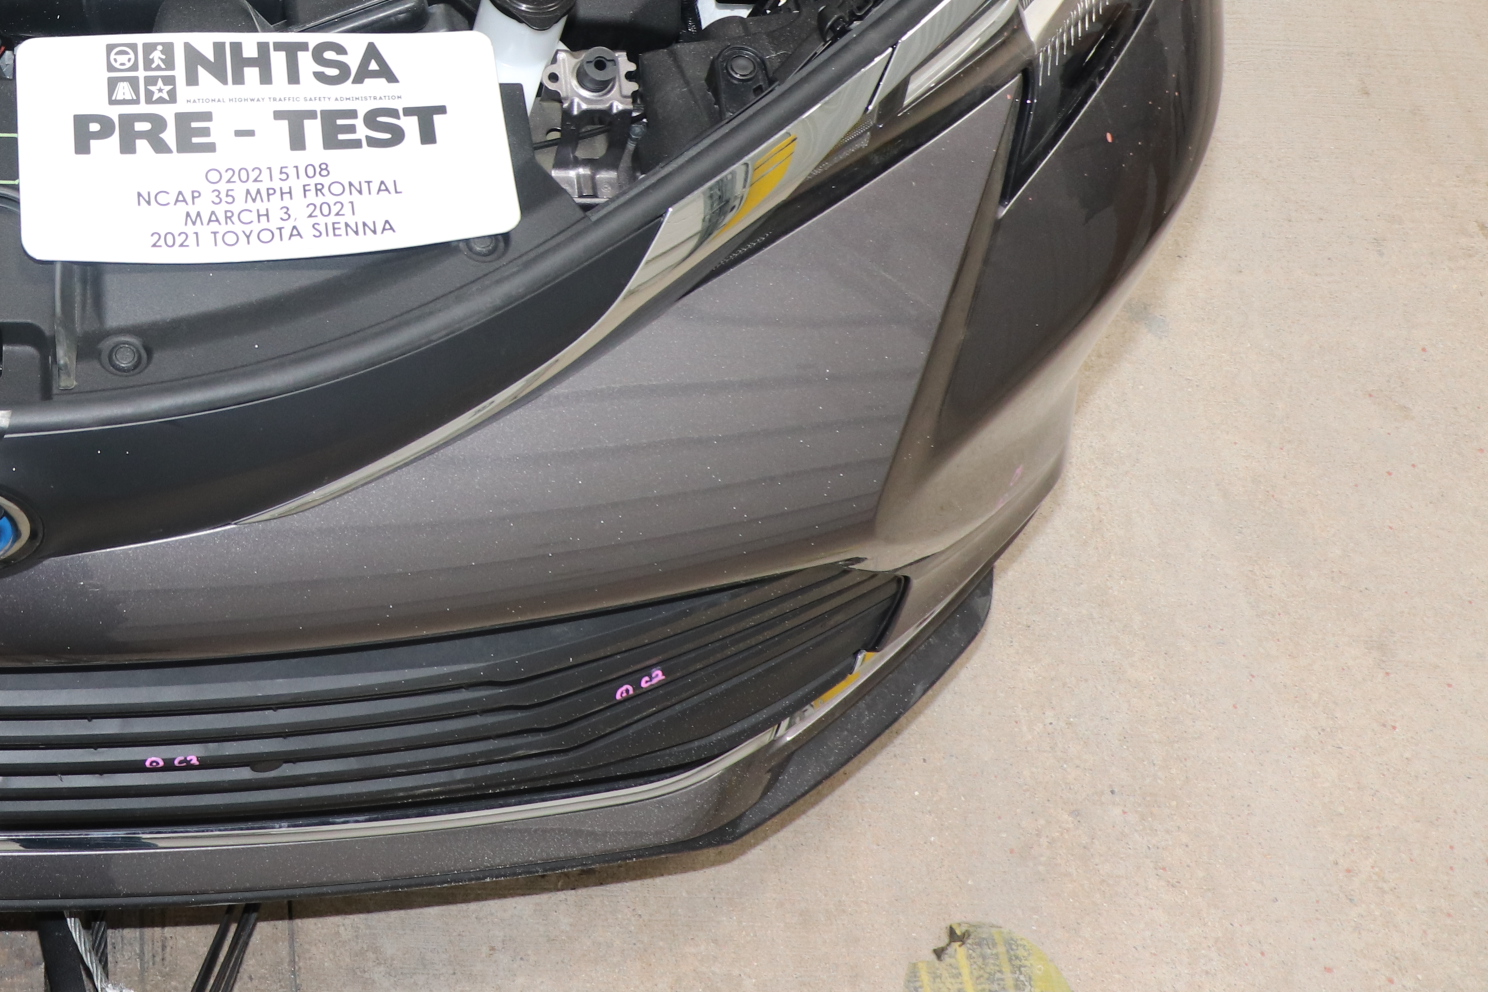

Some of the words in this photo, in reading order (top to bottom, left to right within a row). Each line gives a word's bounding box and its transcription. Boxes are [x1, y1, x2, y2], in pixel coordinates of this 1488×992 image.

[184, 42, 400, 87] NHTSA
[334, 94, 403, 102] ADMINISTRATION
[73, 111, 216, 155] PRE
[273, 105, 448, 151] TEST
[137, 189, 202, 207] NCAP
[211, 189, 235, 205] 35
[245, 185, 293, 203] MPH
[303, 180, 403, 198] FRONTAL
[185, 207, 270, 227] MARCH
[280, 206, 298, 223] 3,
[307, 201, 356, 218] 2021
[150, 231, 200, 248] 2021
[210, 225, 303, 247] TOYOTA
[311, 220, 396, 239] SIENNA
